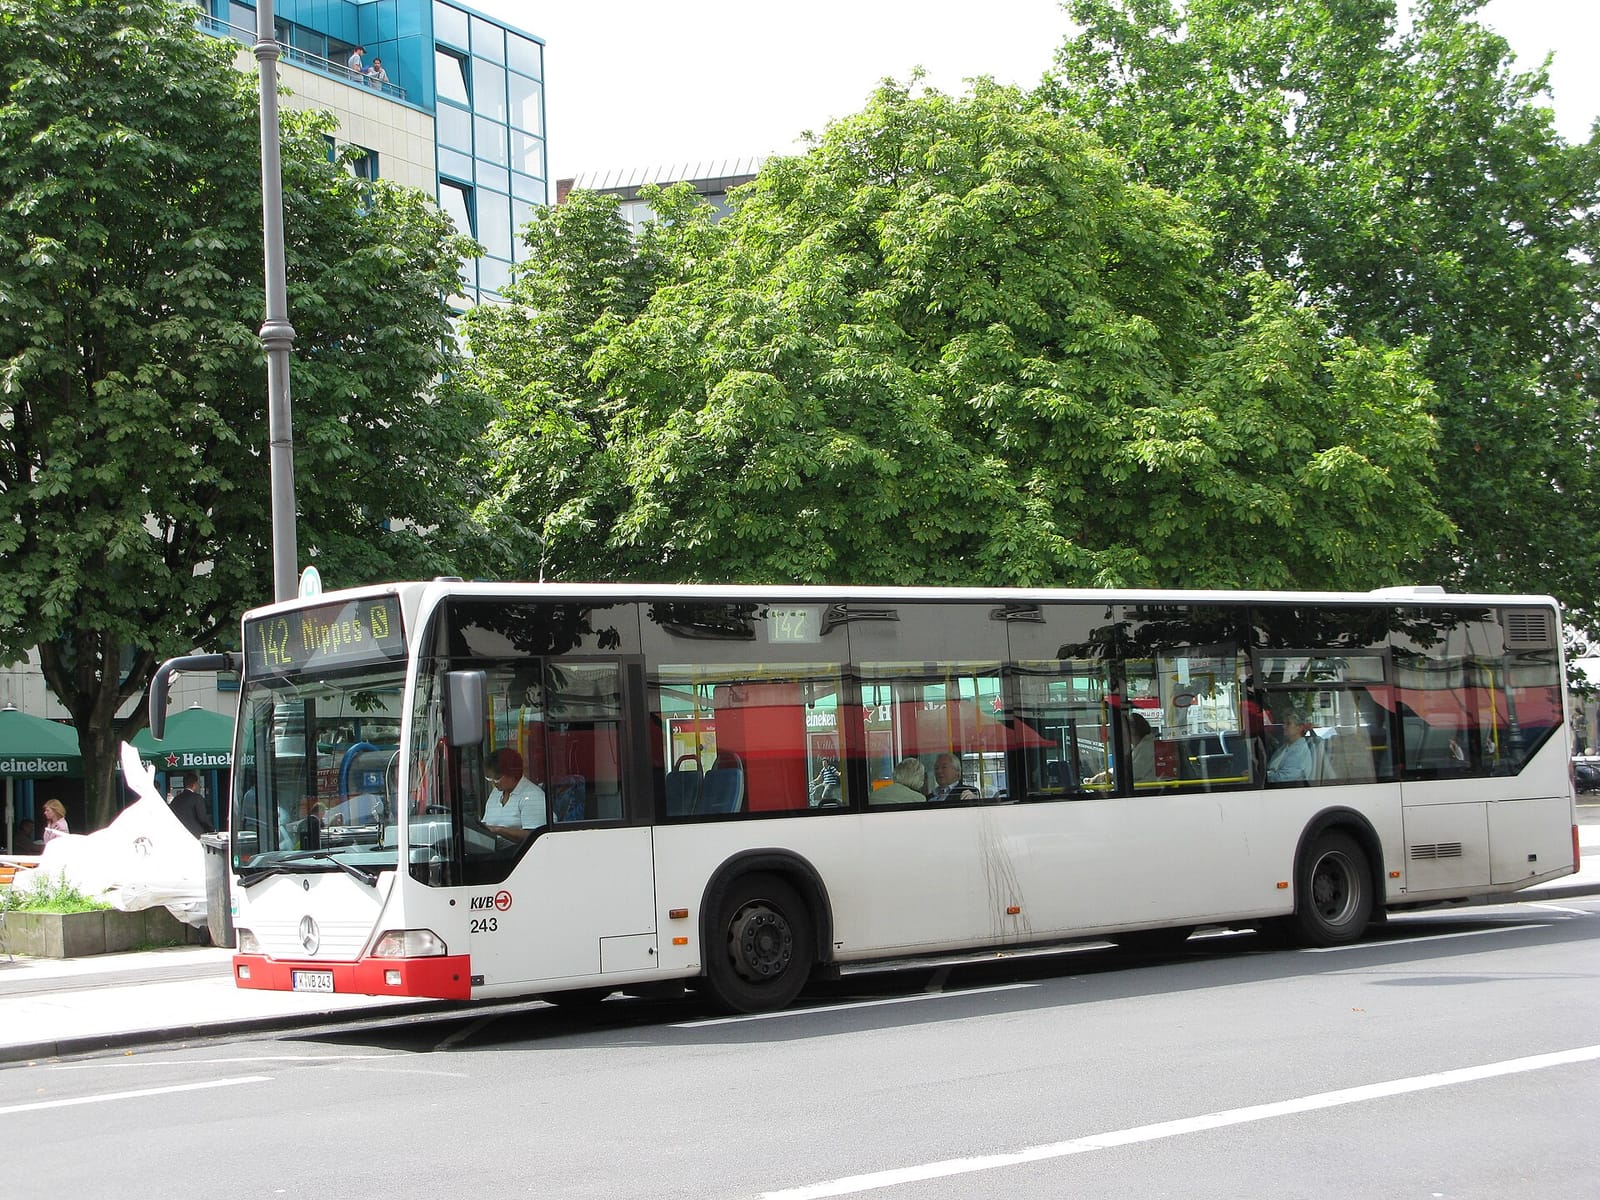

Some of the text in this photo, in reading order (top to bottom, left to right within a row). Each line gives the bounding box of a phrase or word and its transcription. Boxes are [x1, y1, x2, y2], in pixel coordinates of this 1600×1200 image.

[770, 608, 806, 639] 142
[258, 617, 292, 666] 142
[302, 617, 362, 655] Nippes
[806, 710, 837, 727] eineken
[0, 758, 69, 772] eineken
[470, 896, 494, 910] KVB
[470, 917, 498, 934] 243
[317, 975, 331, 988] 243
